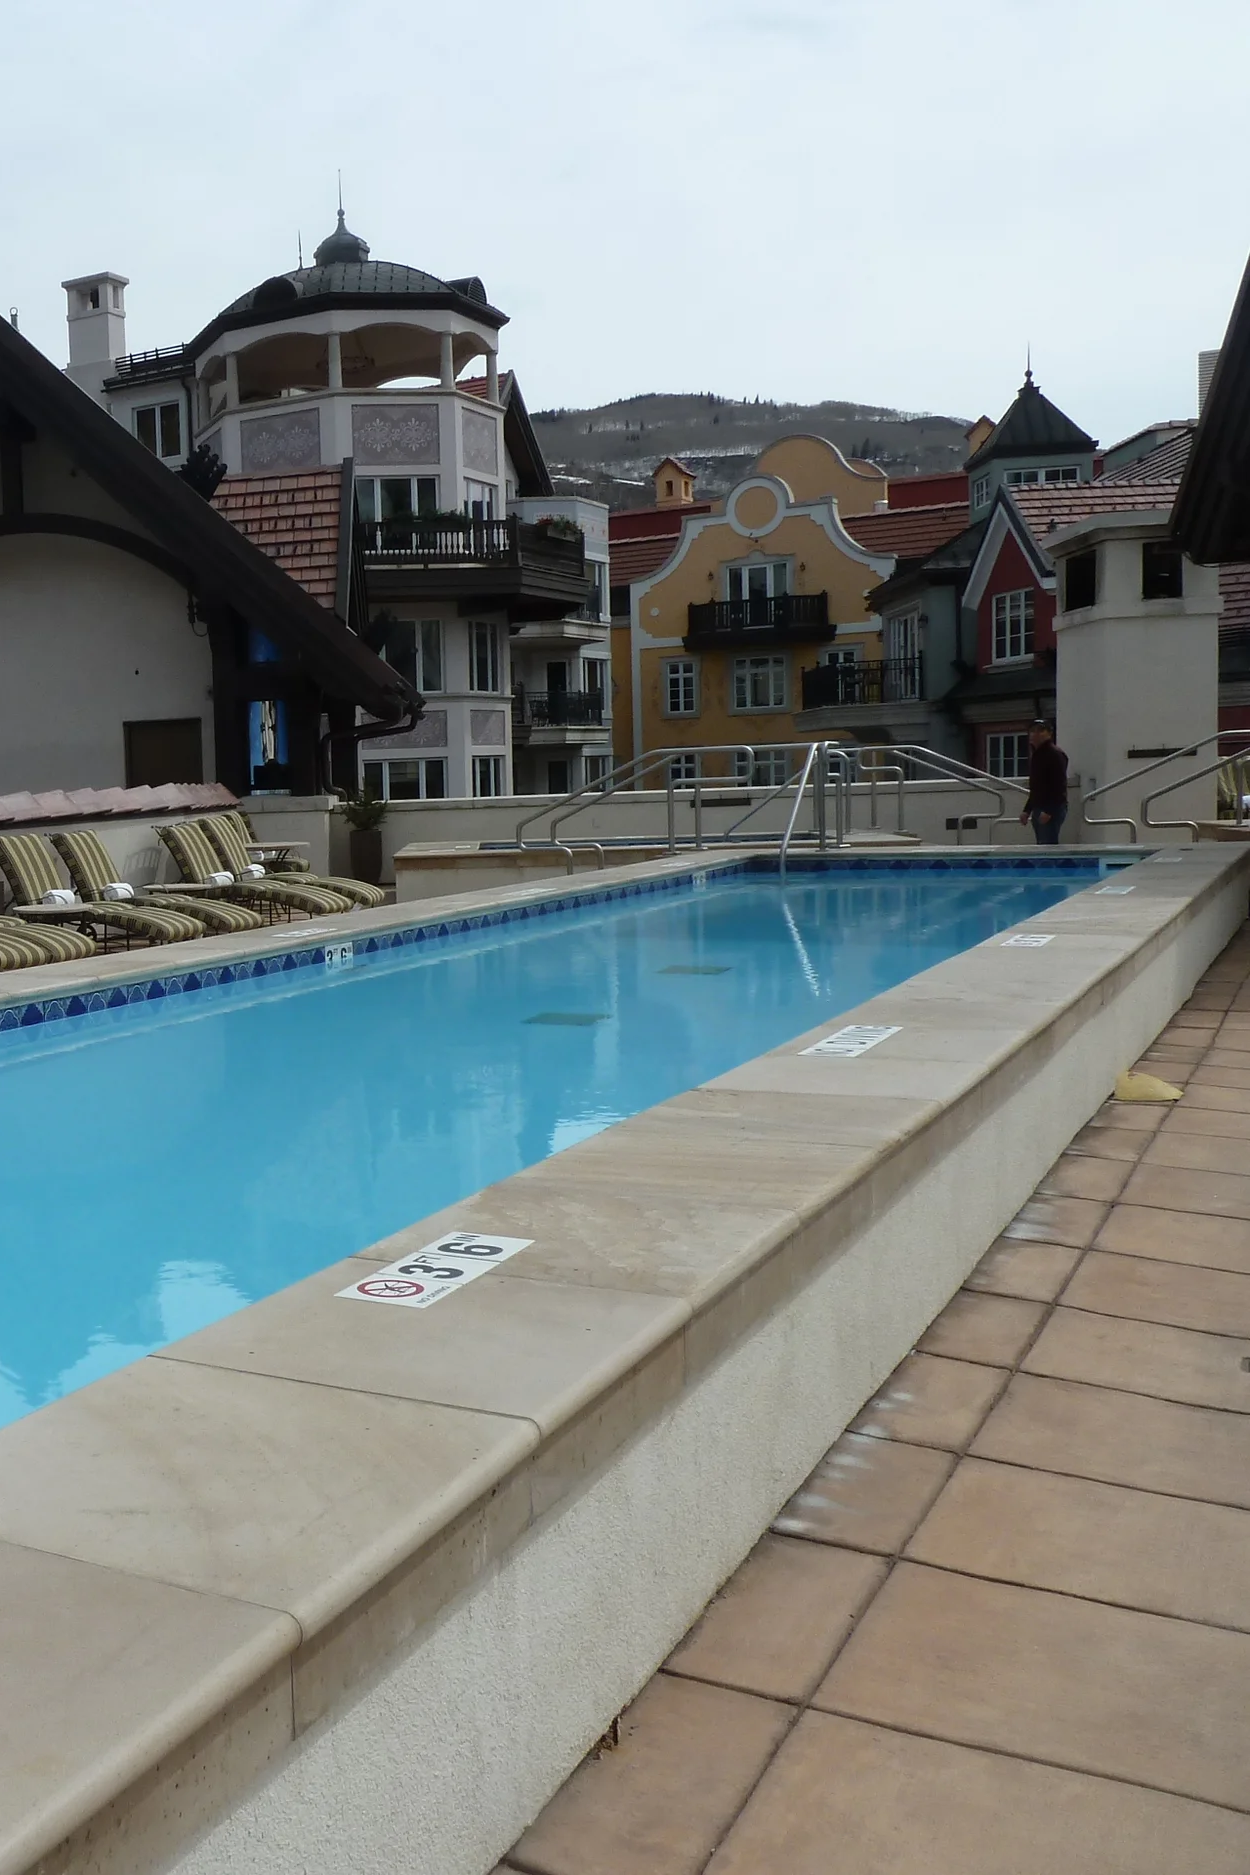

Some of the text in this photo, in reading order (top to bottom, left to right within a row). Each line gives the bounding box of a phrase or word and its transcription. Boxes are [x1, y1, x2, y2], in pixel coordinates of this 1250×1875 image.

[397, 1232, 504, 1279] 3 FT 6 IN
